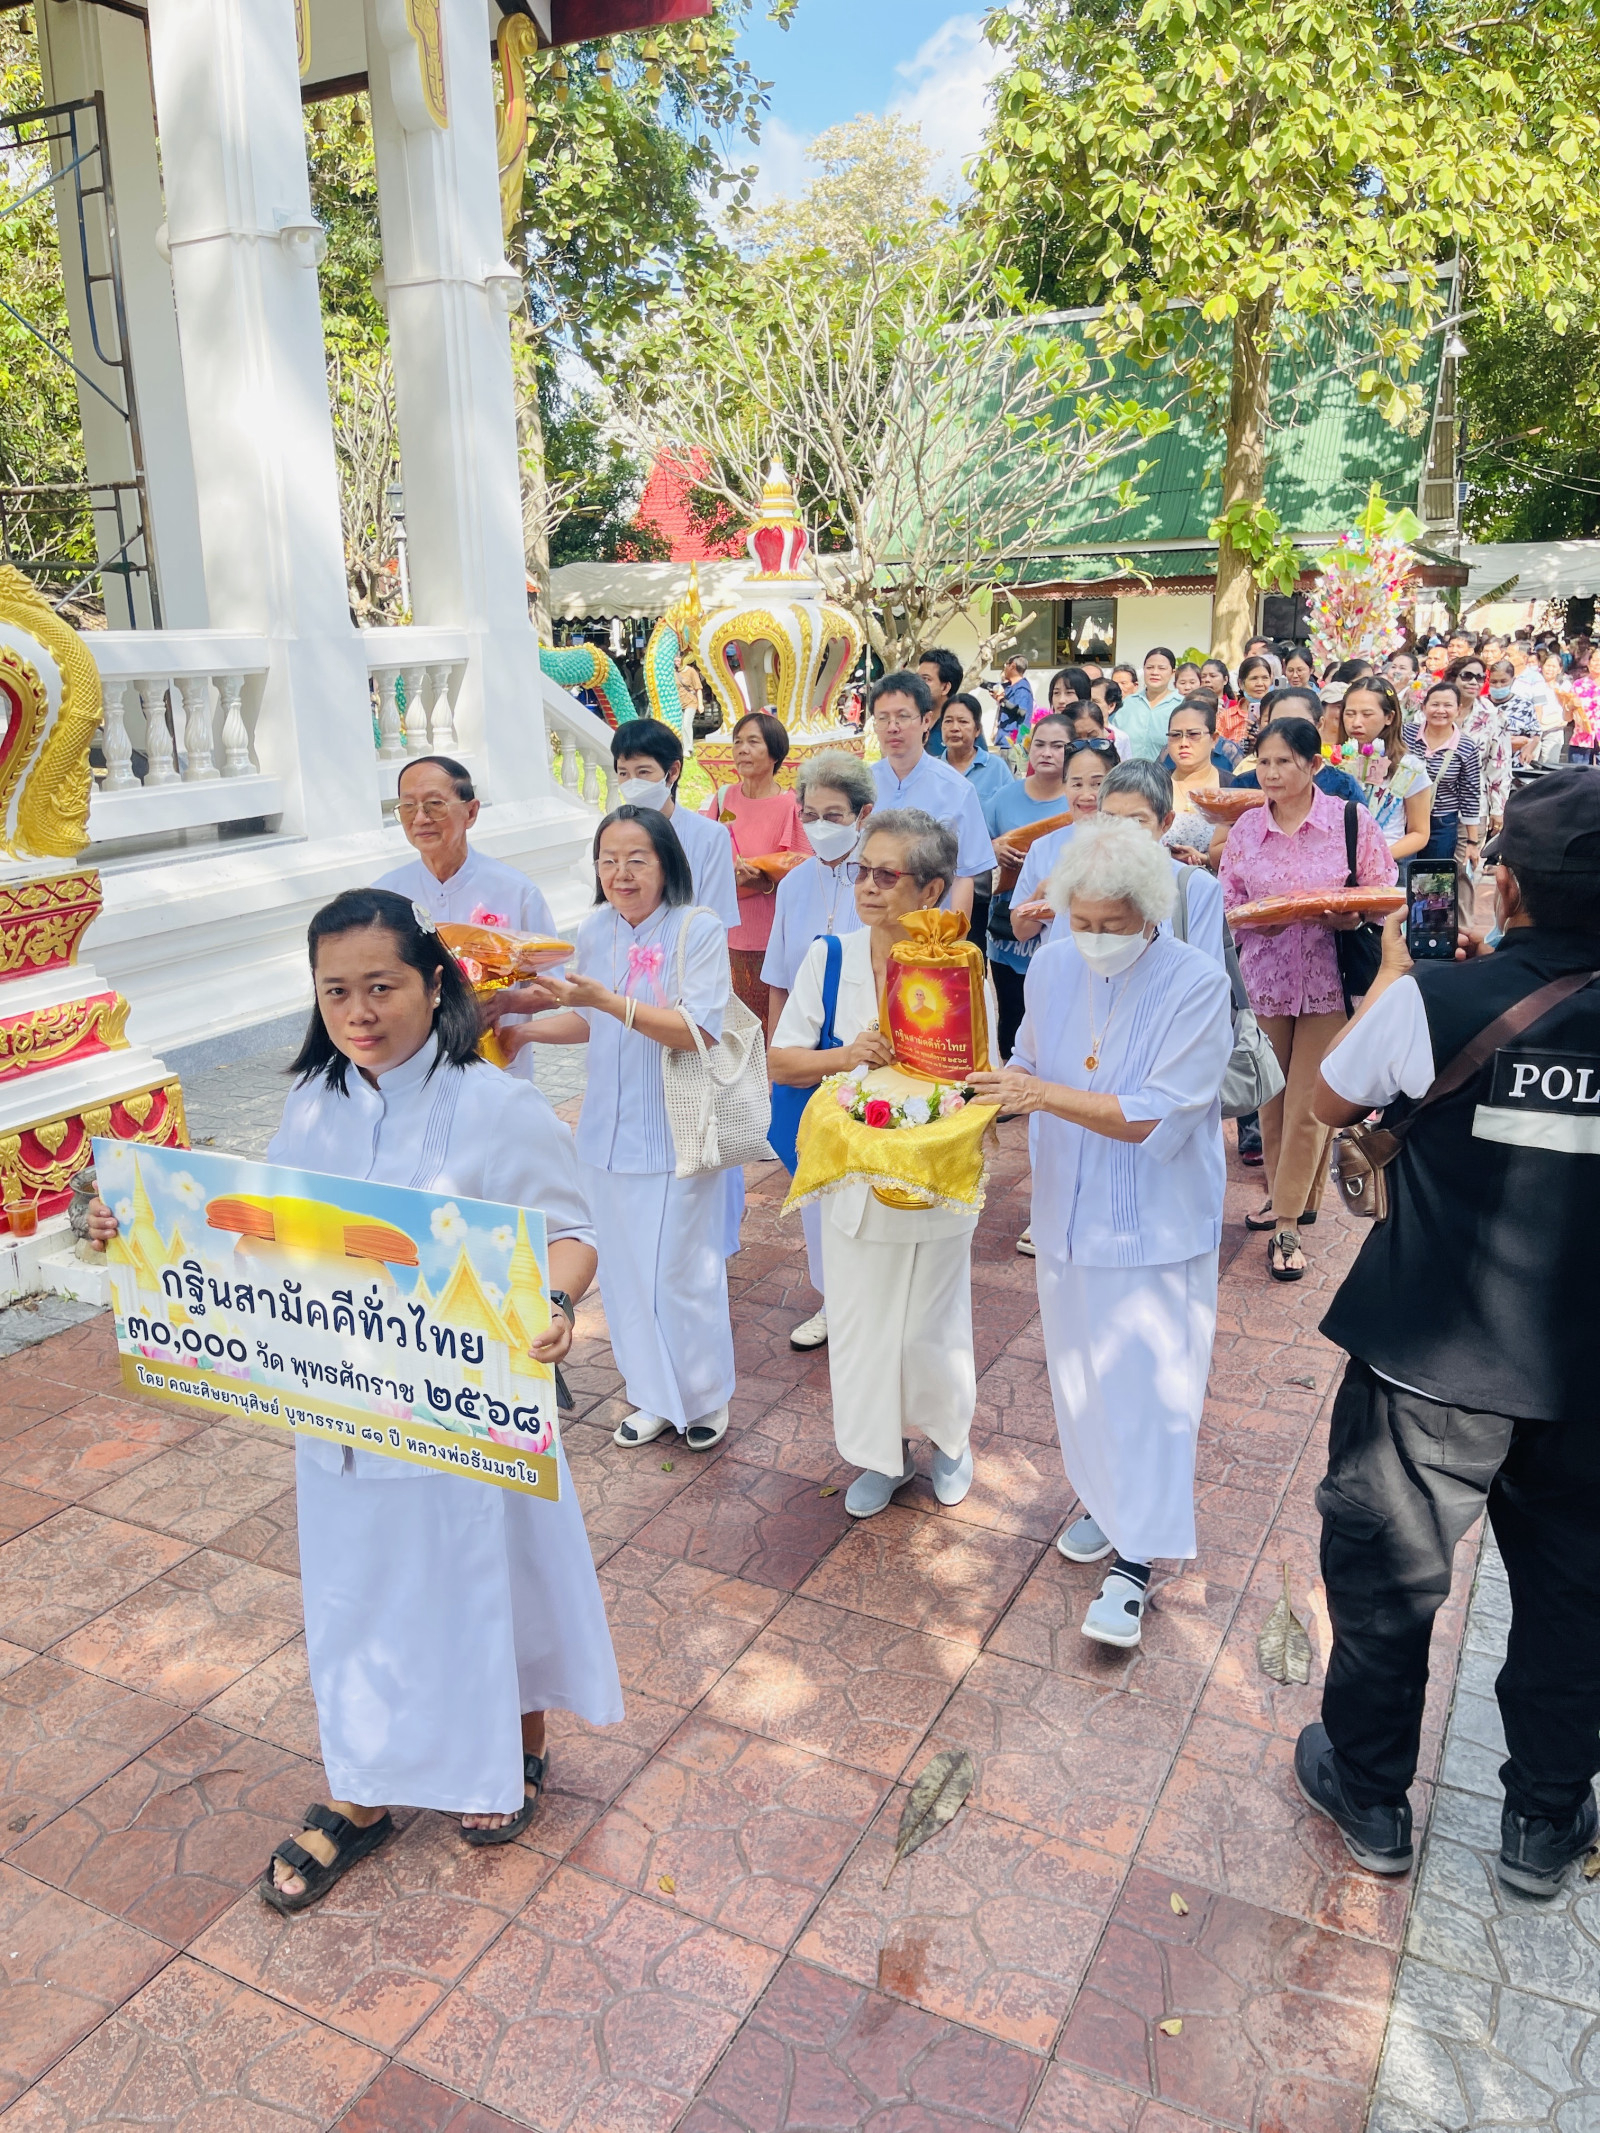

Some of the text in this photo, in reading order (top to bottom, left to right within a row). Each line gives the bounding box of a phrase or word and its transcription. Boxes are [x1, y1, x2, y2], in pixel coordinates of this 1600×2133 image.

[1508, 1063, 1600, 1103] POL
[162, 1259, 484, 1364] กฐินสามัคคีทั่วไทย
[128, 1316, 541, 1435] ๓๐,๐๐๐ วัด พุทธศักราช ๒๕๖๘
[137, 1366, 537, 1484] โดย คณะศิษยานุศิษย์ บูชาธรรม ๘๑ ปี หลวงพ่อธัมมชโย
